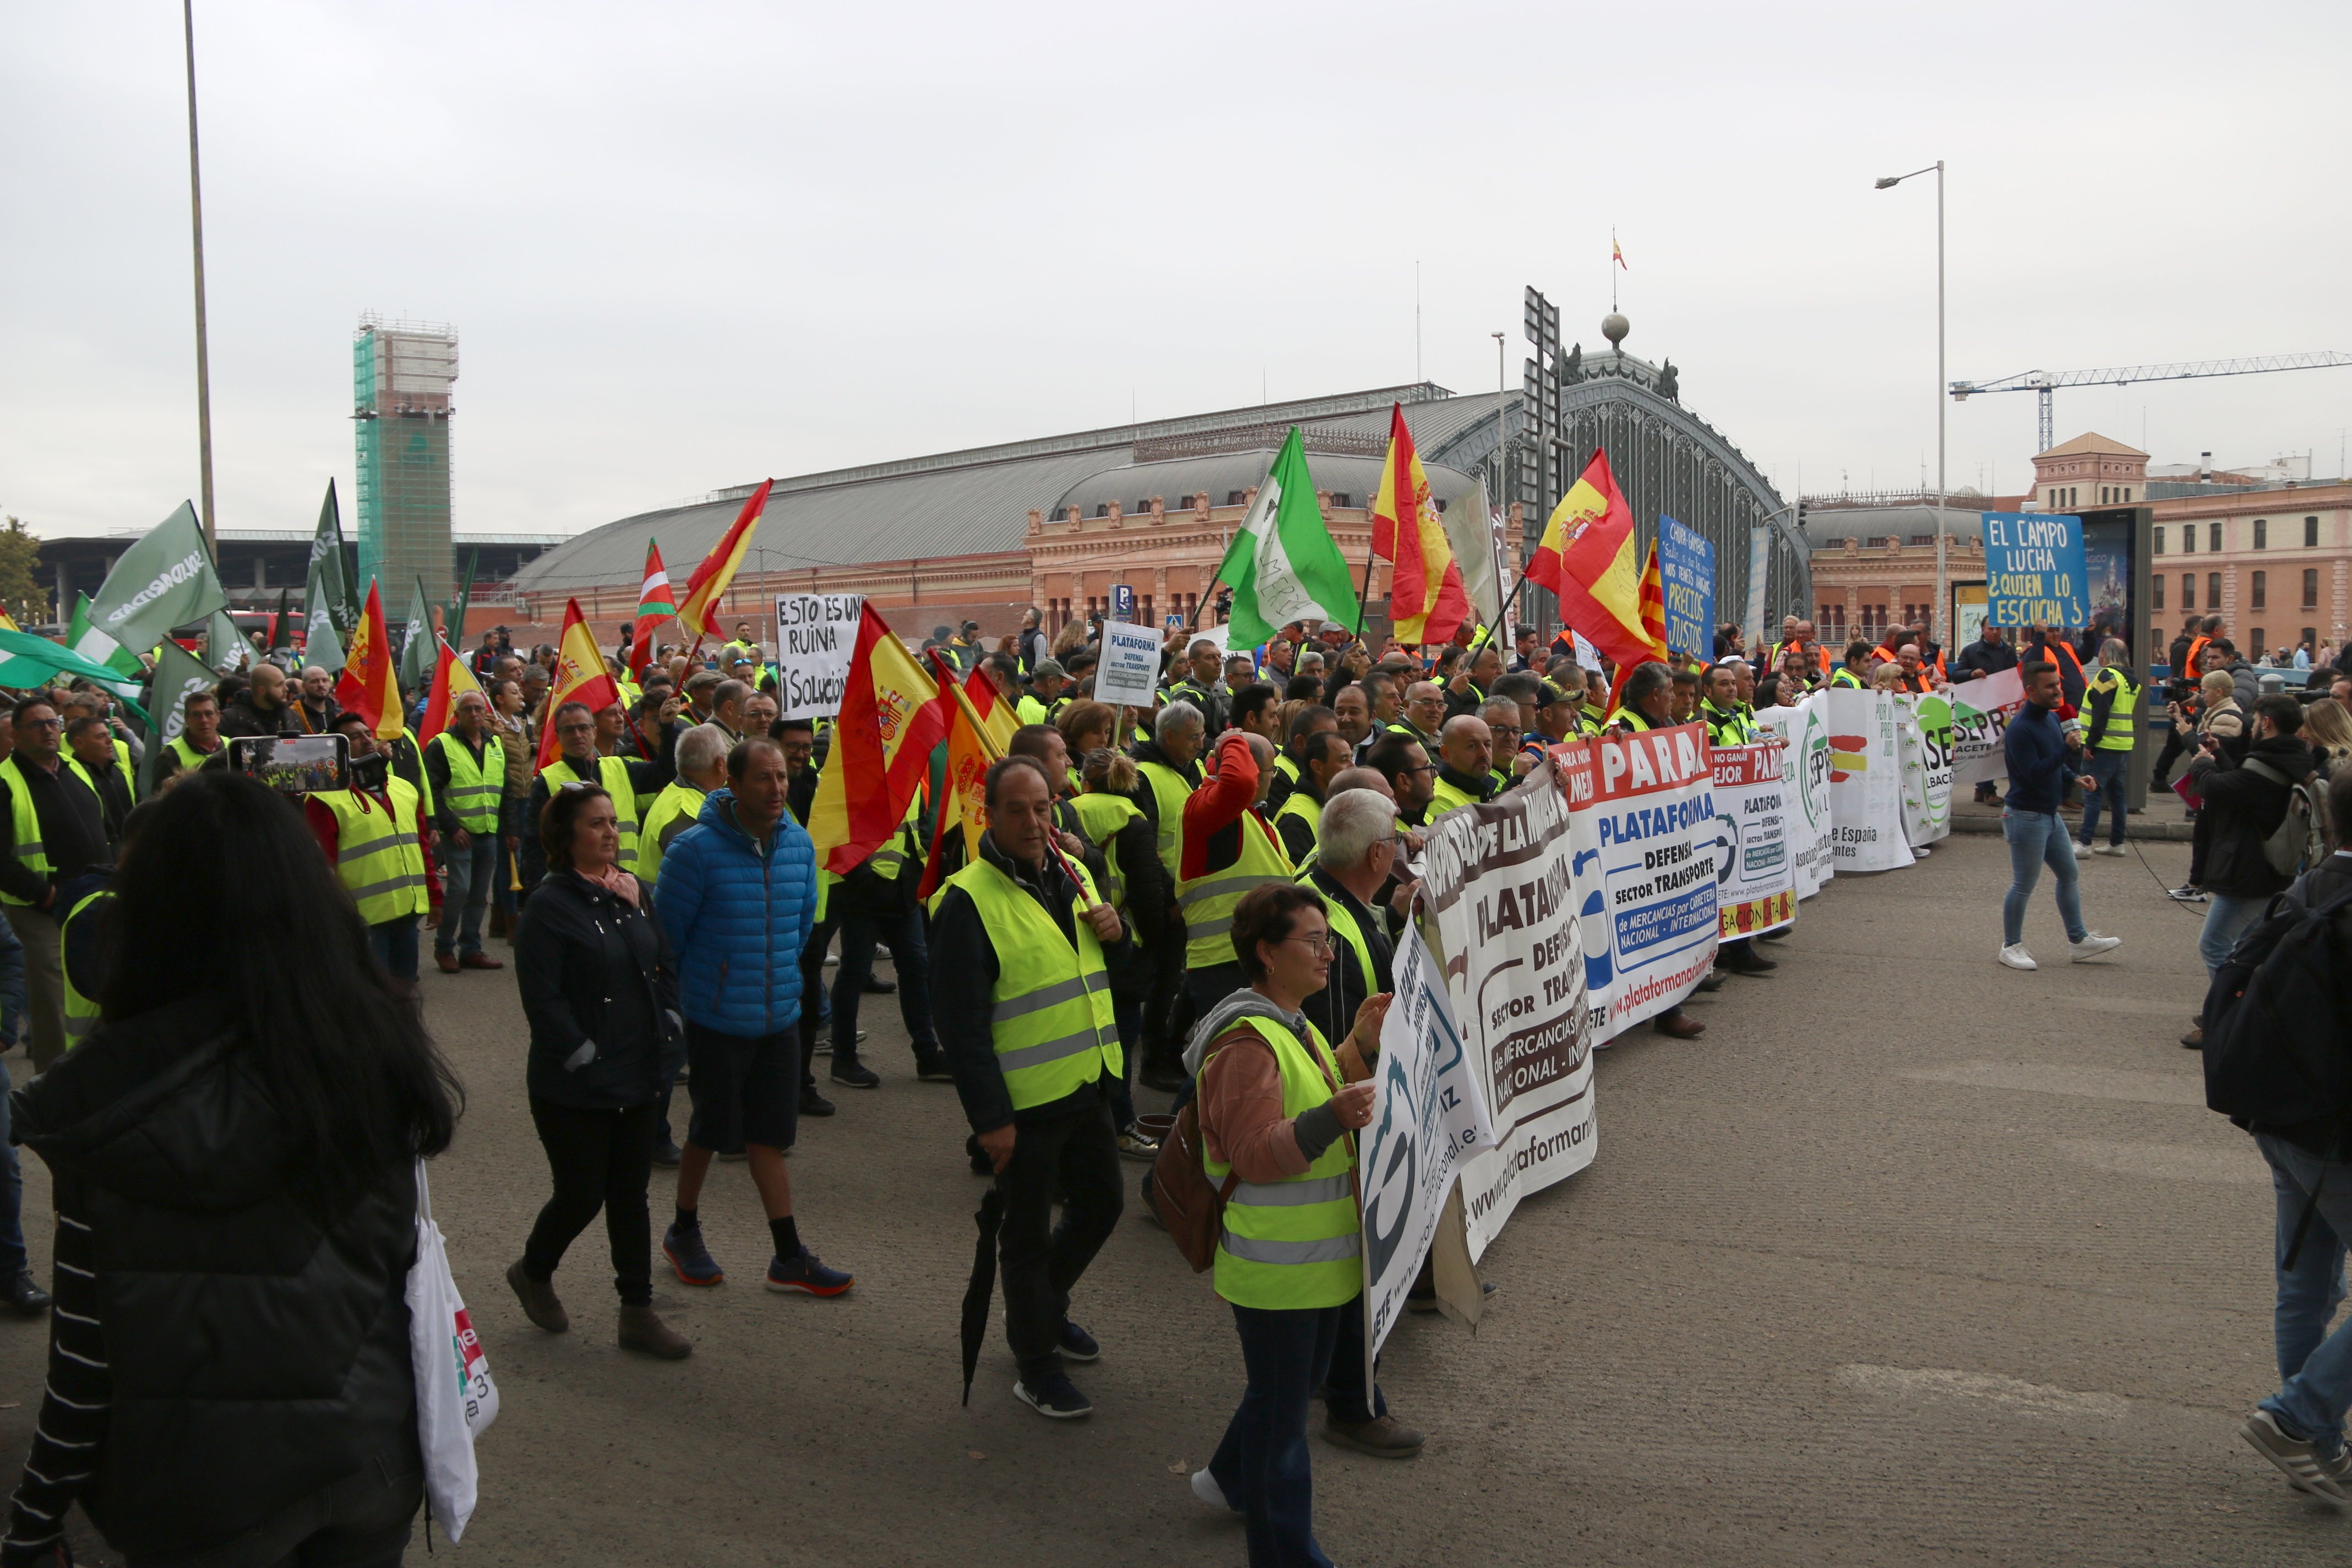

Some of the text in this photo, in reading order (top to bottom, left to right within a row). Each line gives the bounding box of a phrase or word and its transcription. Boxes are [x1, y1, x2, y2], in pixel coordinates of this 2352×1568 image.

[1989, 520, 2067, 547] EL CAMPO
[1665, 563, 1676, 578] NOS
[2007, 549, 2056, 571] LUCHA
[1988, 571, 2070, 597] ¿QUIEN LO
[778, 596, 819, 626] ESTO
[824, 596, 842, 622] ES
[1668, 582, 1703, 622] PRECIOS
[1997, 598, 2064, 626] ESCUCHA
[1111, 635, 1156, 652] PLATAFORMA
[1668, 616, 1702, 655] JUSTOS
[1124, 652, 1144, 662] DEFENSA
[1126, 662, 1151, 672] TRANSPORTE
[1875, 703, 1887, 720] POR
[1558, 751, 1578, 769] PARA
[1714, 752, 1747, 763] NO GANAR
[1955, 743, 1992, 753] ACETE
[1713, 766, 1743, 784] EJOR
[1598, 792, 1716, 848] PLATAFORMA
[1478, 821, 1498, 861] DE
[1503, 815, 1527, 853] LA
[1832, 826, 1877, 845] e España
[1645, 840, 1692, 870] DEFENSA
[1615, 857, 1714, 905] SECTOR TRANSPORTE
[1718, 889, 1730, 900] ETE:
[1619, 887, 1715, 933] de MERCANCIAS por CARRETERA
[1620, 926, 1659, 950] NACIONAL
[1669, 903, 1716, 933] INTERNACIONAL
[1491, 995, 1536, 1031] SECTOR
[1589, 1005, 1606, 1030] ETE
[1494, 1052, 1504, 1074] de
[1504, 1016, 1575, 1066] MERCANCIAS
